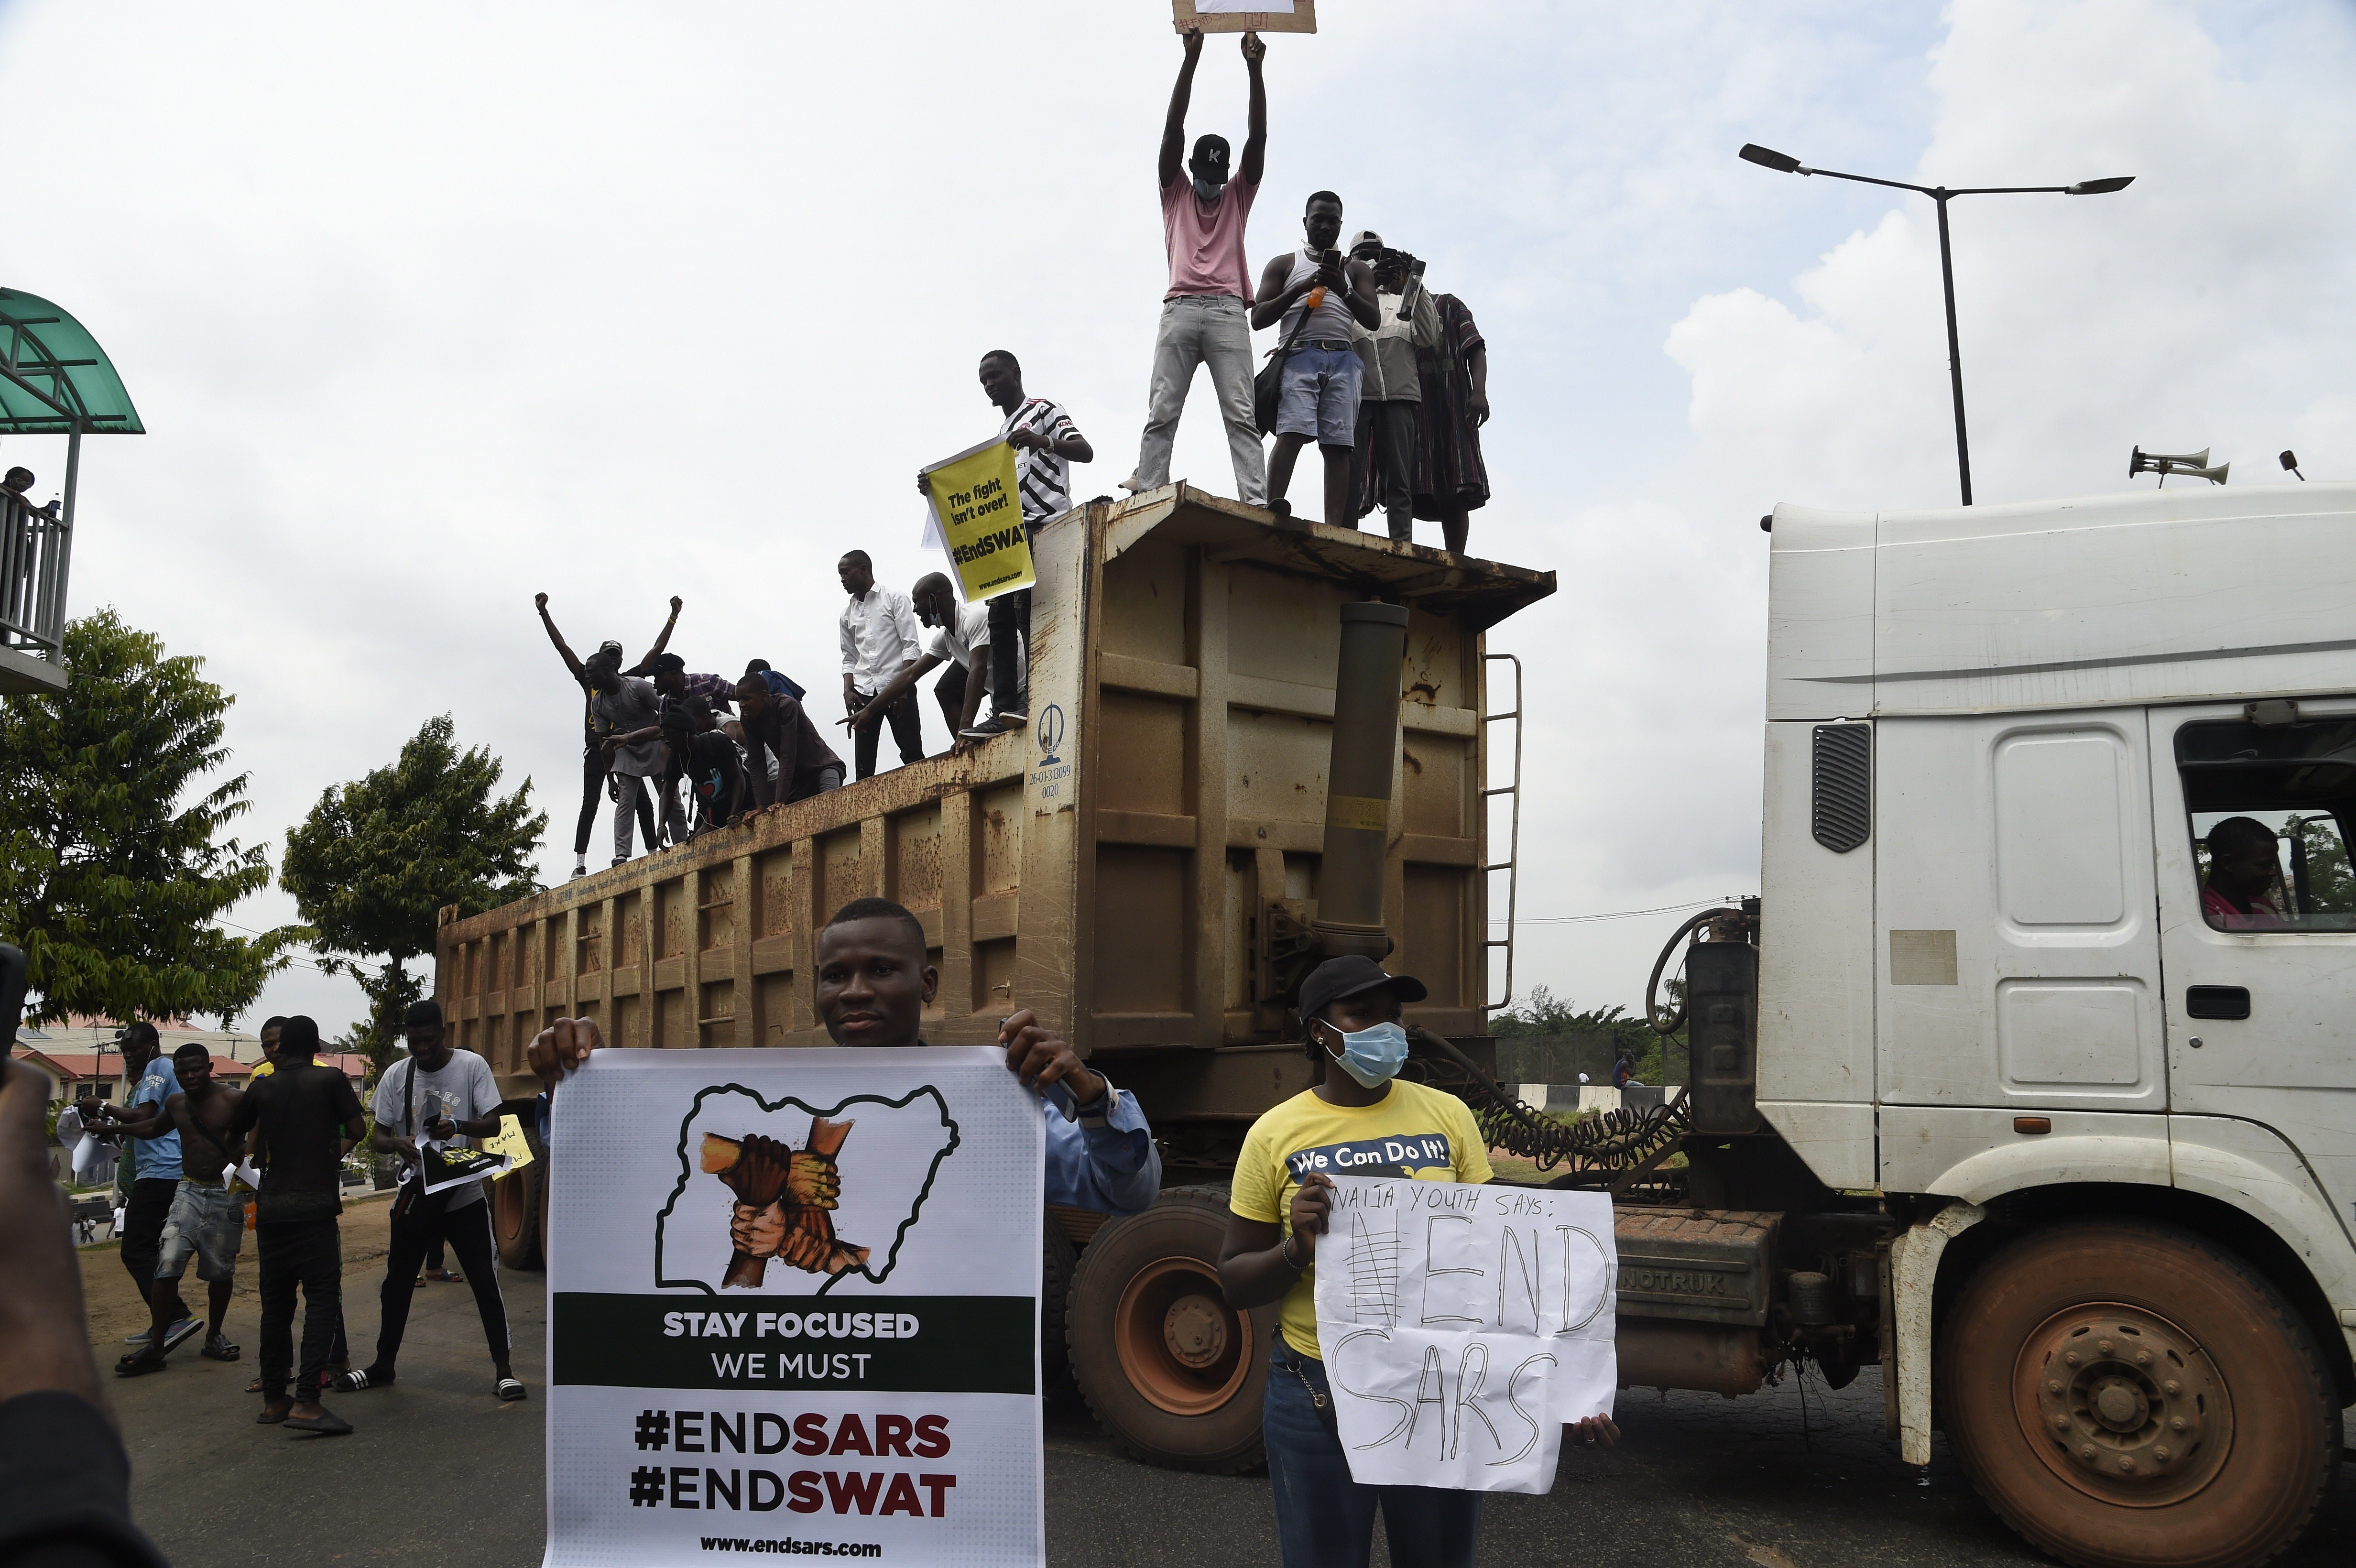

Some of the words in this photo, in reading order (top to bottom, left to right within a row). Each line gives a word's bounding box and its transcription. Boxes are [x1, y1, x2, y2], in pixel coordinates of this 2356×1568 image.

[948, 492, 971, 509] The
[973, 477, 1002, 500] fight
[950, 506, 976, 526] isn't
[977, 493, 1009, 516] over!
[979, 571, 1022, 591] www.endsars.com
[1029, 764, 1071, 785] 26-01-313099
[1042, 783, 1059, 799] 0020
[1292, 1151, 1328, 1175] We
[1334, 1147, 1382, 1167] Can
[1385, 1142, 1419, 1162] Do
[1420, 1140, 1446, 1160] It!
[1331, 1179, 1402, 1212] NAIJA
[1410, 1186, 1482, 1212] YOUTH
[1494, 1193, 1554, 1218] SAYS:
[1421, 1215, 1610, 1334] END
[663, 1311, 749, 1338] STAY
[756, 1312, 920, 1339] FOCUSED
[711, 1352, 766, 1378] WE
[779, 1353, 872, 1379] MUST
[1331, 1328, 1559, 1467] SARS
[634, 1409, 951, 1459] #ENDSARS
[629, 1465, 957, 1518] #ENDSWAT
[700, 1536, 882, 1558] www.endsars.com
